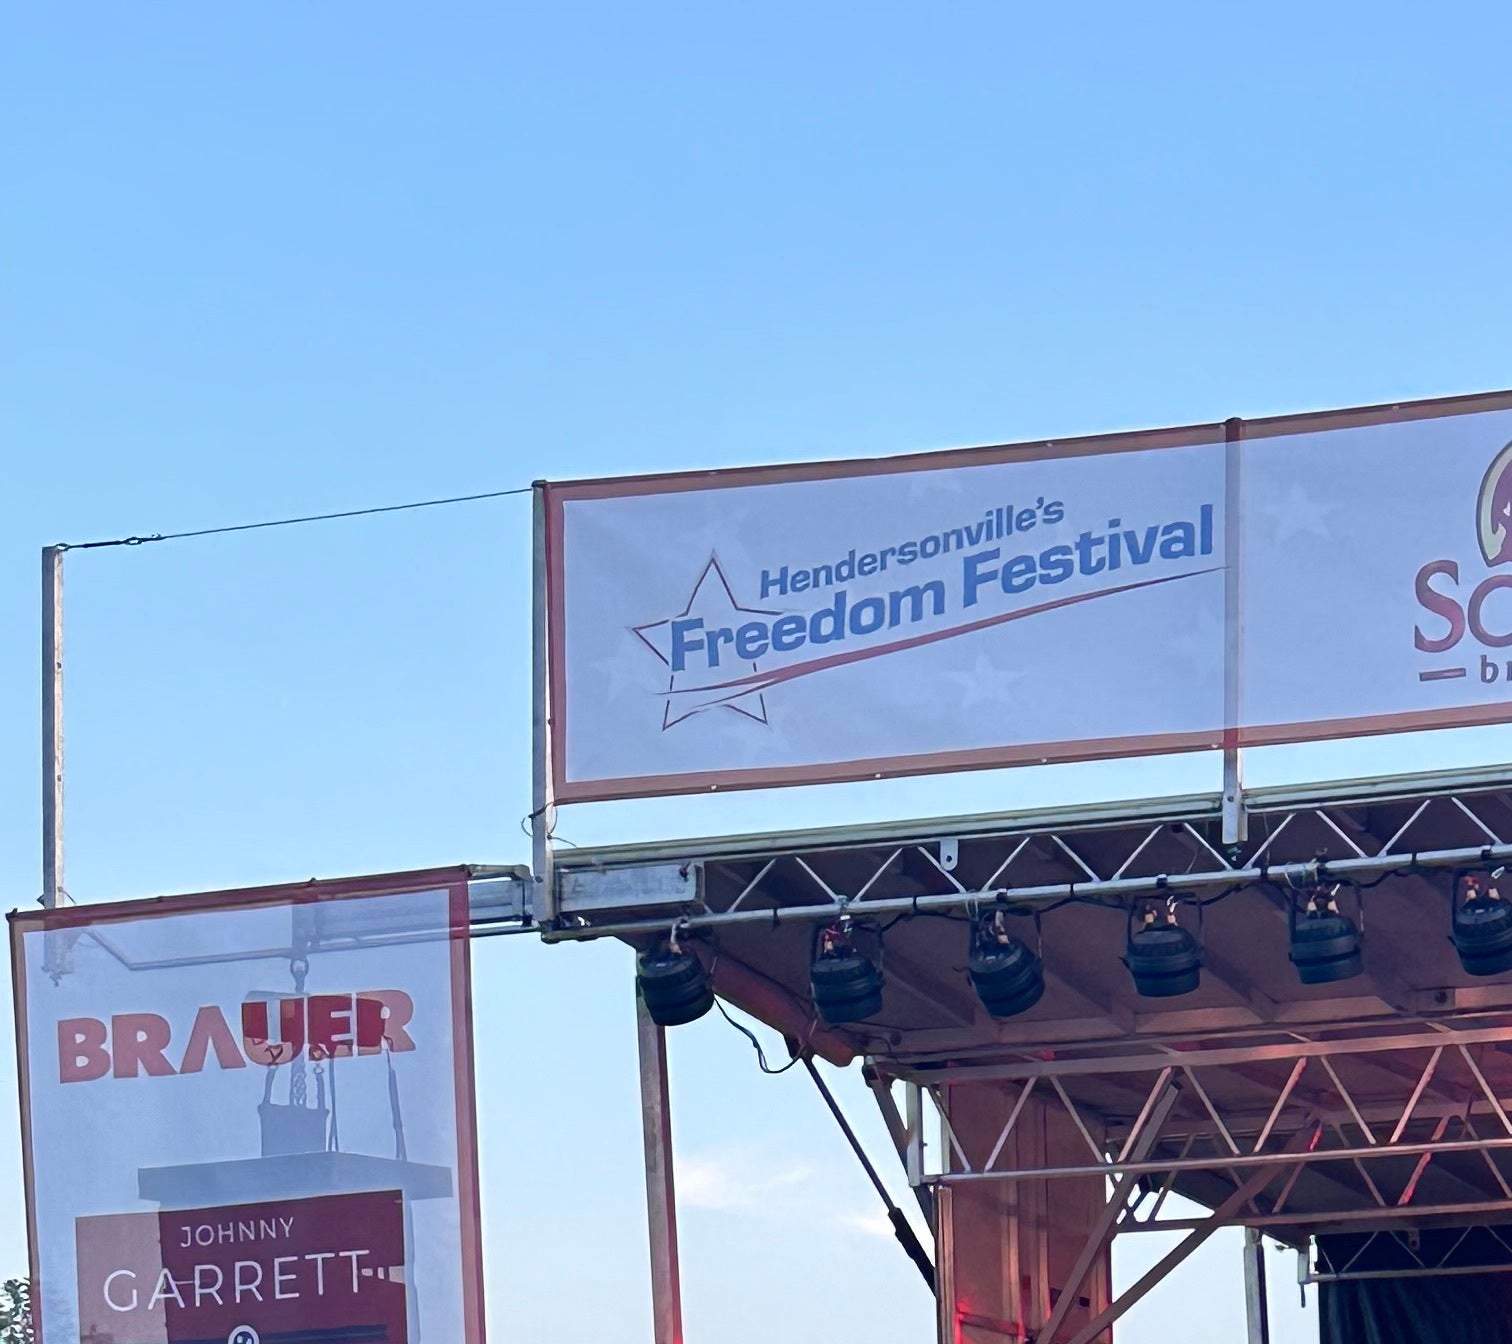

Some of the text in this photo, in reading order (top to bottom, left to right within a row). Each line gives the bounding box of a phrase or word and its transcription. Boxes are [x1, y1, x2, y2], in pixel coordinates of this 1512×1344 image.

[671, 504, 1214, 671] Freedom Festival
[759, 496, 1064, 599] Hendersonville's
[57, 989, 417, 1083] BRAUER
[180, 1217, 294, 1248] JOHNNY
[103, 1250, 370, 1312] GARRETT
